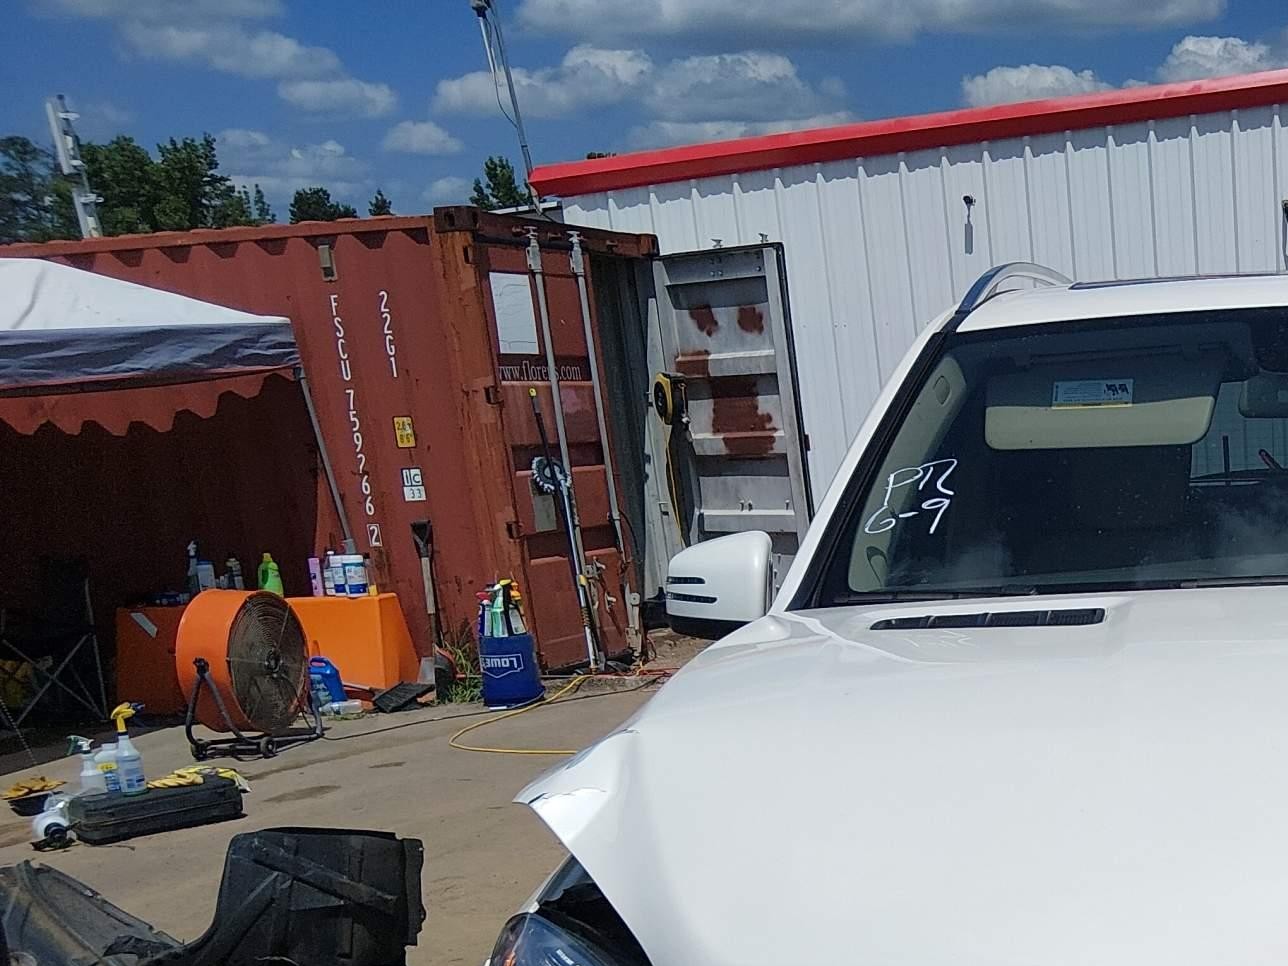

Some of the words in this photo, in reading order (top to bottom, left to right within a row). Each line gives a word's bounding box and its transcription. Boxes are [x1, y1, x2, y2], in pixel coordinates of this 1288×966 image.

[379, 290, 398, 378] 22G1
[330, 294, 352, 381] FSCU
[369, 525, 380, 546] 2
[864, 498, 951, 534] 6-9
